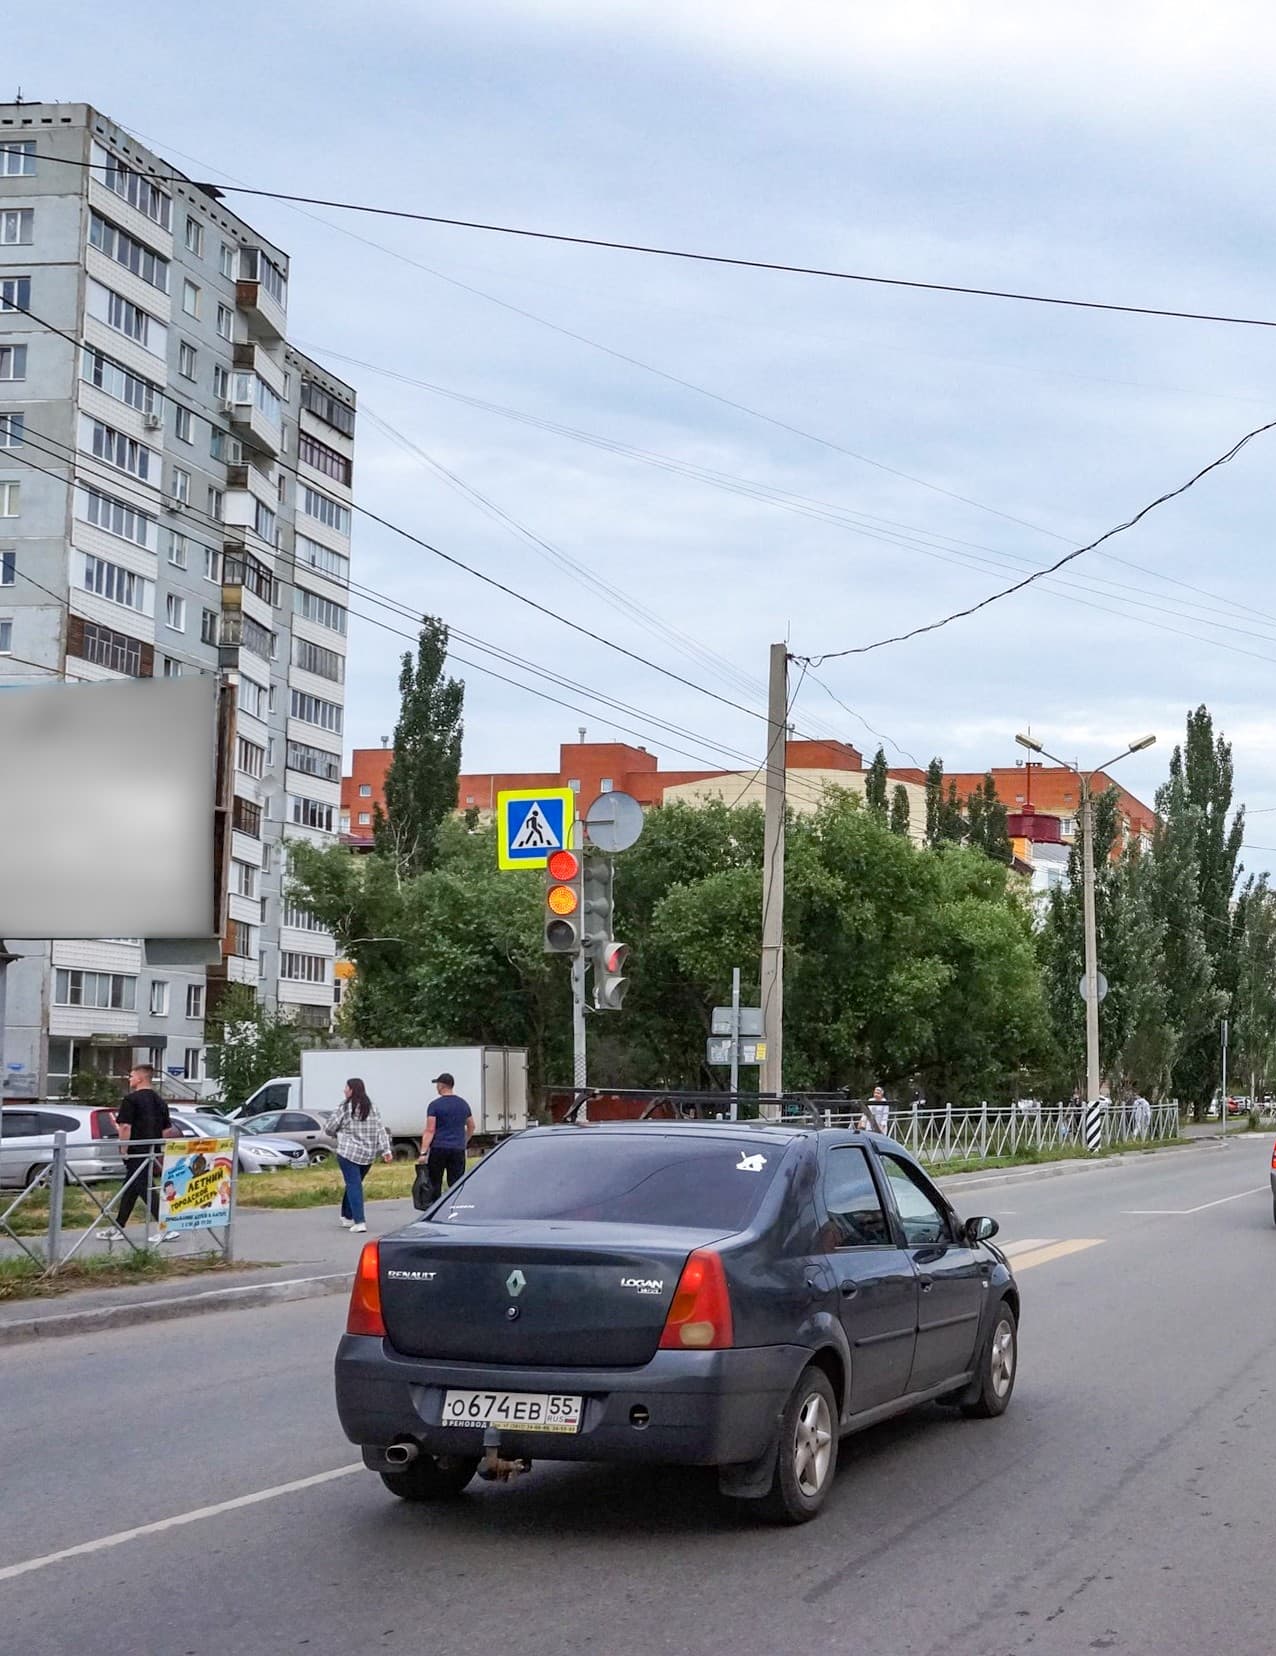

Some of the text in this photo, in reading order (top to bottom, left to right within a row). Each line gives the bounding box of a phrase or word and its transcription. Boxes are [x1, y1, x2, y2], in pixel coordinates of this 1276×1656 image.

[187, 1170, 223, 1193] ЛЕТНИЙ
[387, 1270, 437, 1281] RENAULT
[621, 1277, 664, 1288] LOGAN
[550, 1397, 573, 1416] 55
[449, 1421, 487, 1429] РЕНОВОД
